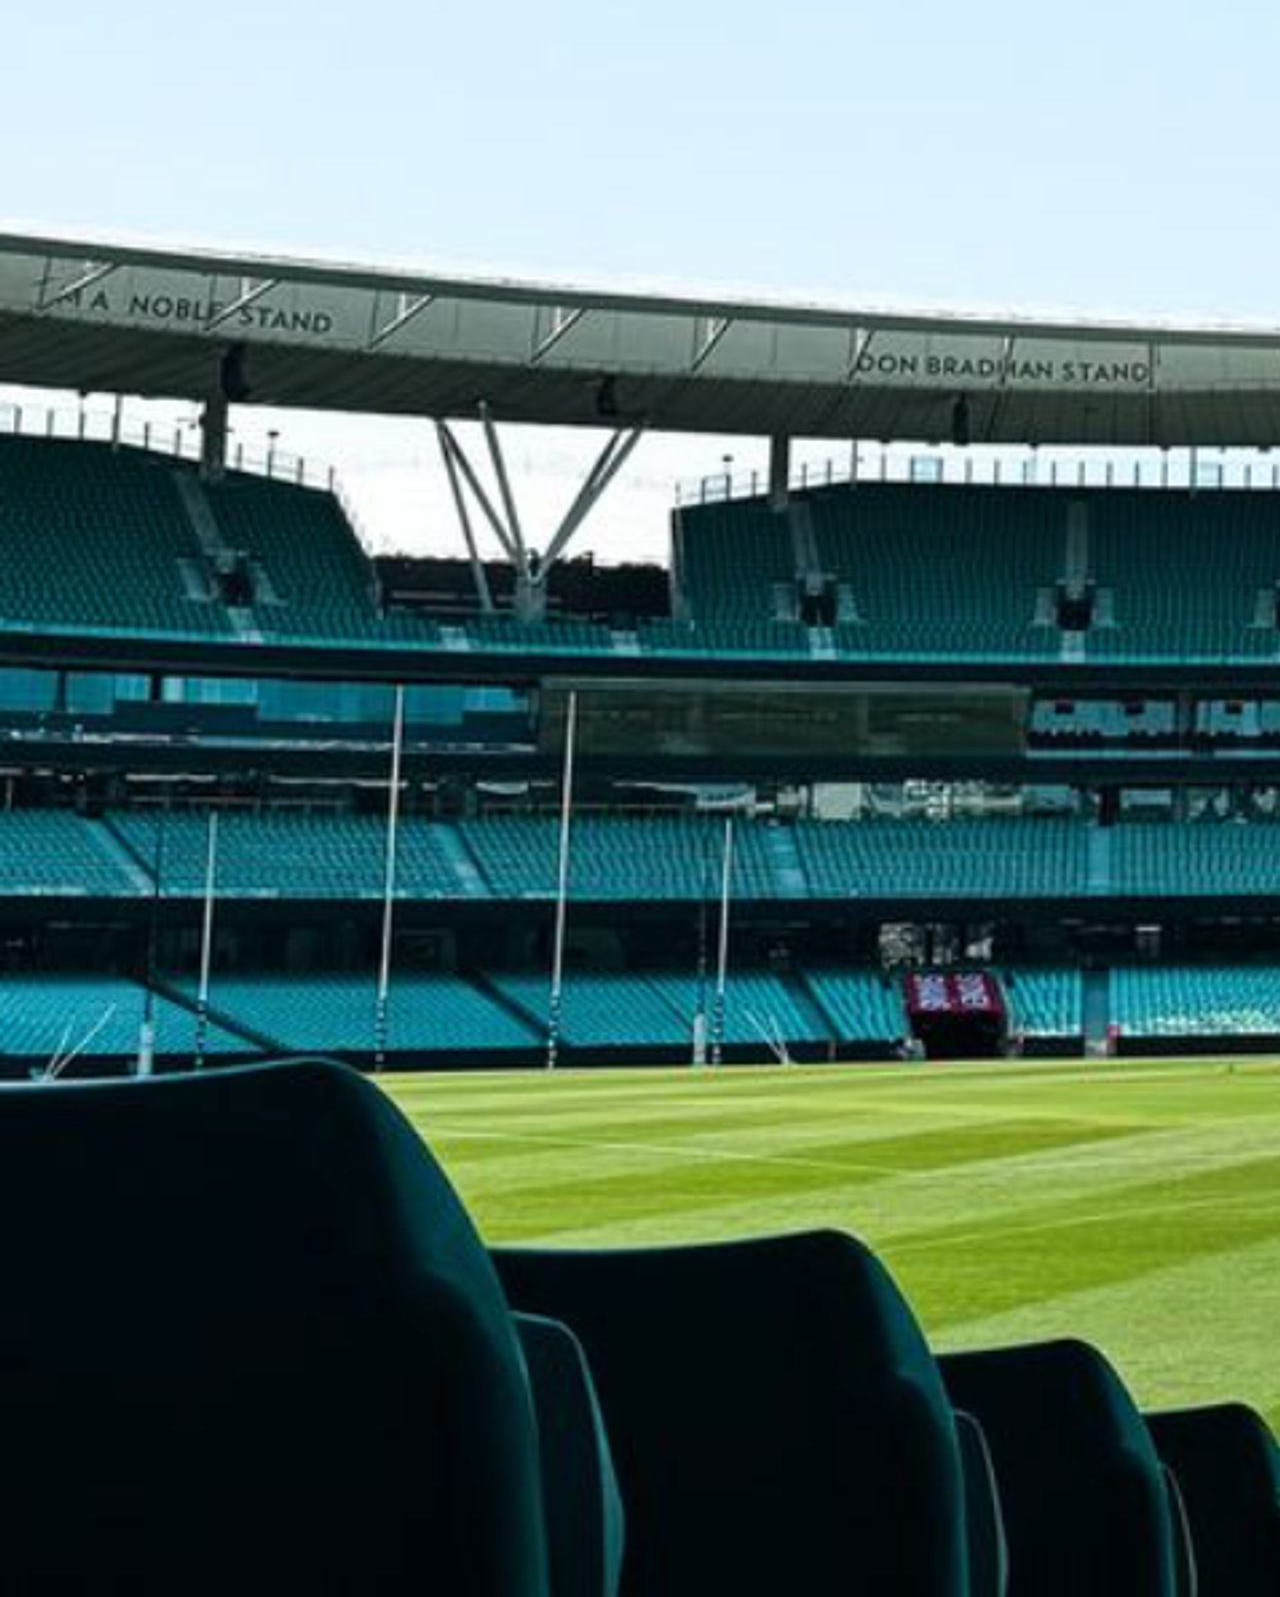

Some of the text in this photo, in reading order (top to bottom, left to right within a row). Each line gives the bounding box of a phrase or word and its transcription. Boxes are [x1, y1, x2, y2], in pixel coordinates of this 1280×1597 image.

[128, 296, 228, 321] NOBLE
[238, 303, 332, 333] STAND
[856, 355, 917, 374] DON
[1061, 361, 1148, 383] STAND
